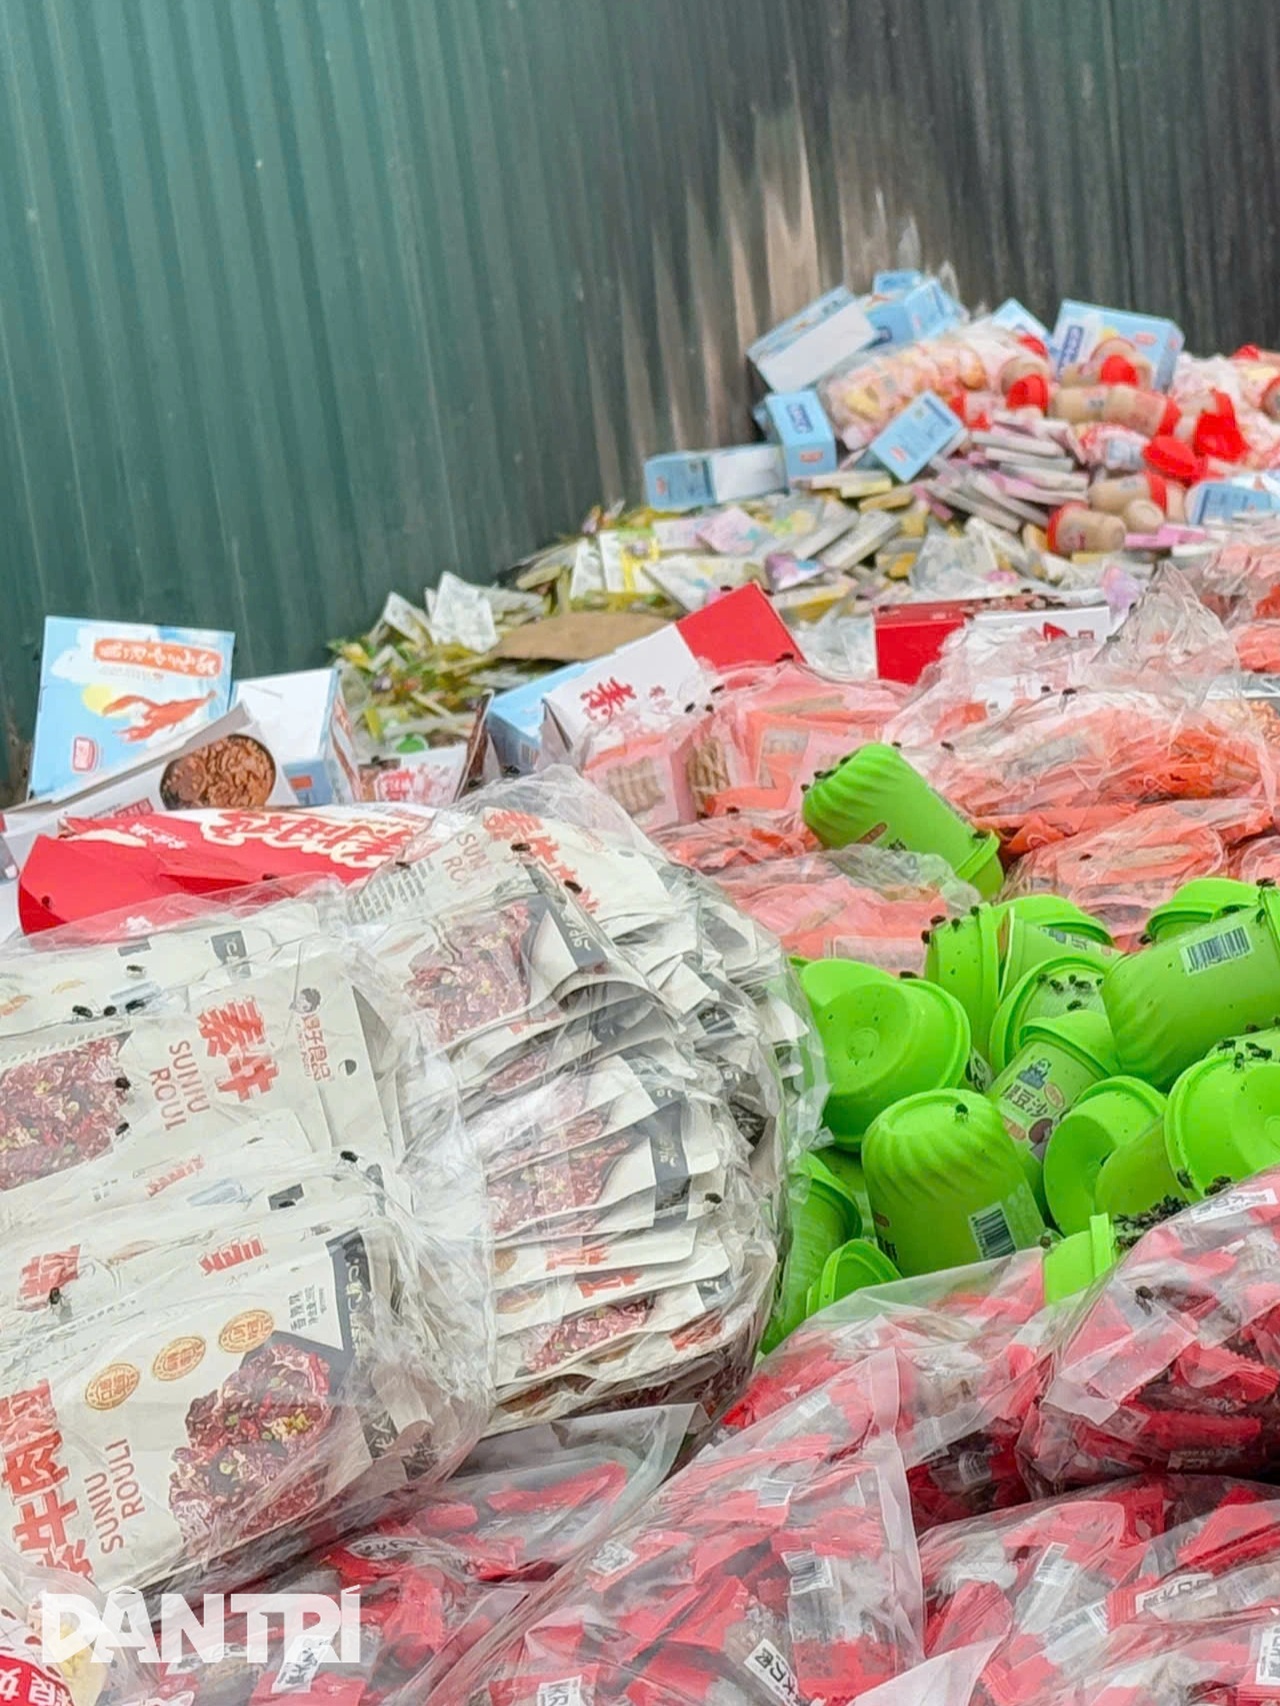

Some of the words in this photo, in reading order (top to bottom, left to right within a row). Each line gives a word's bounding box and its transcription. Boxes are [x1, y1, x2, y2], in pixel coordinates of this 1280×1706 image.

[168, 1039, 211, 1114] SUNIU
[83, 1471, 125, 1555] SUNIU
[104, 1438, 146, 1520] ROULI
